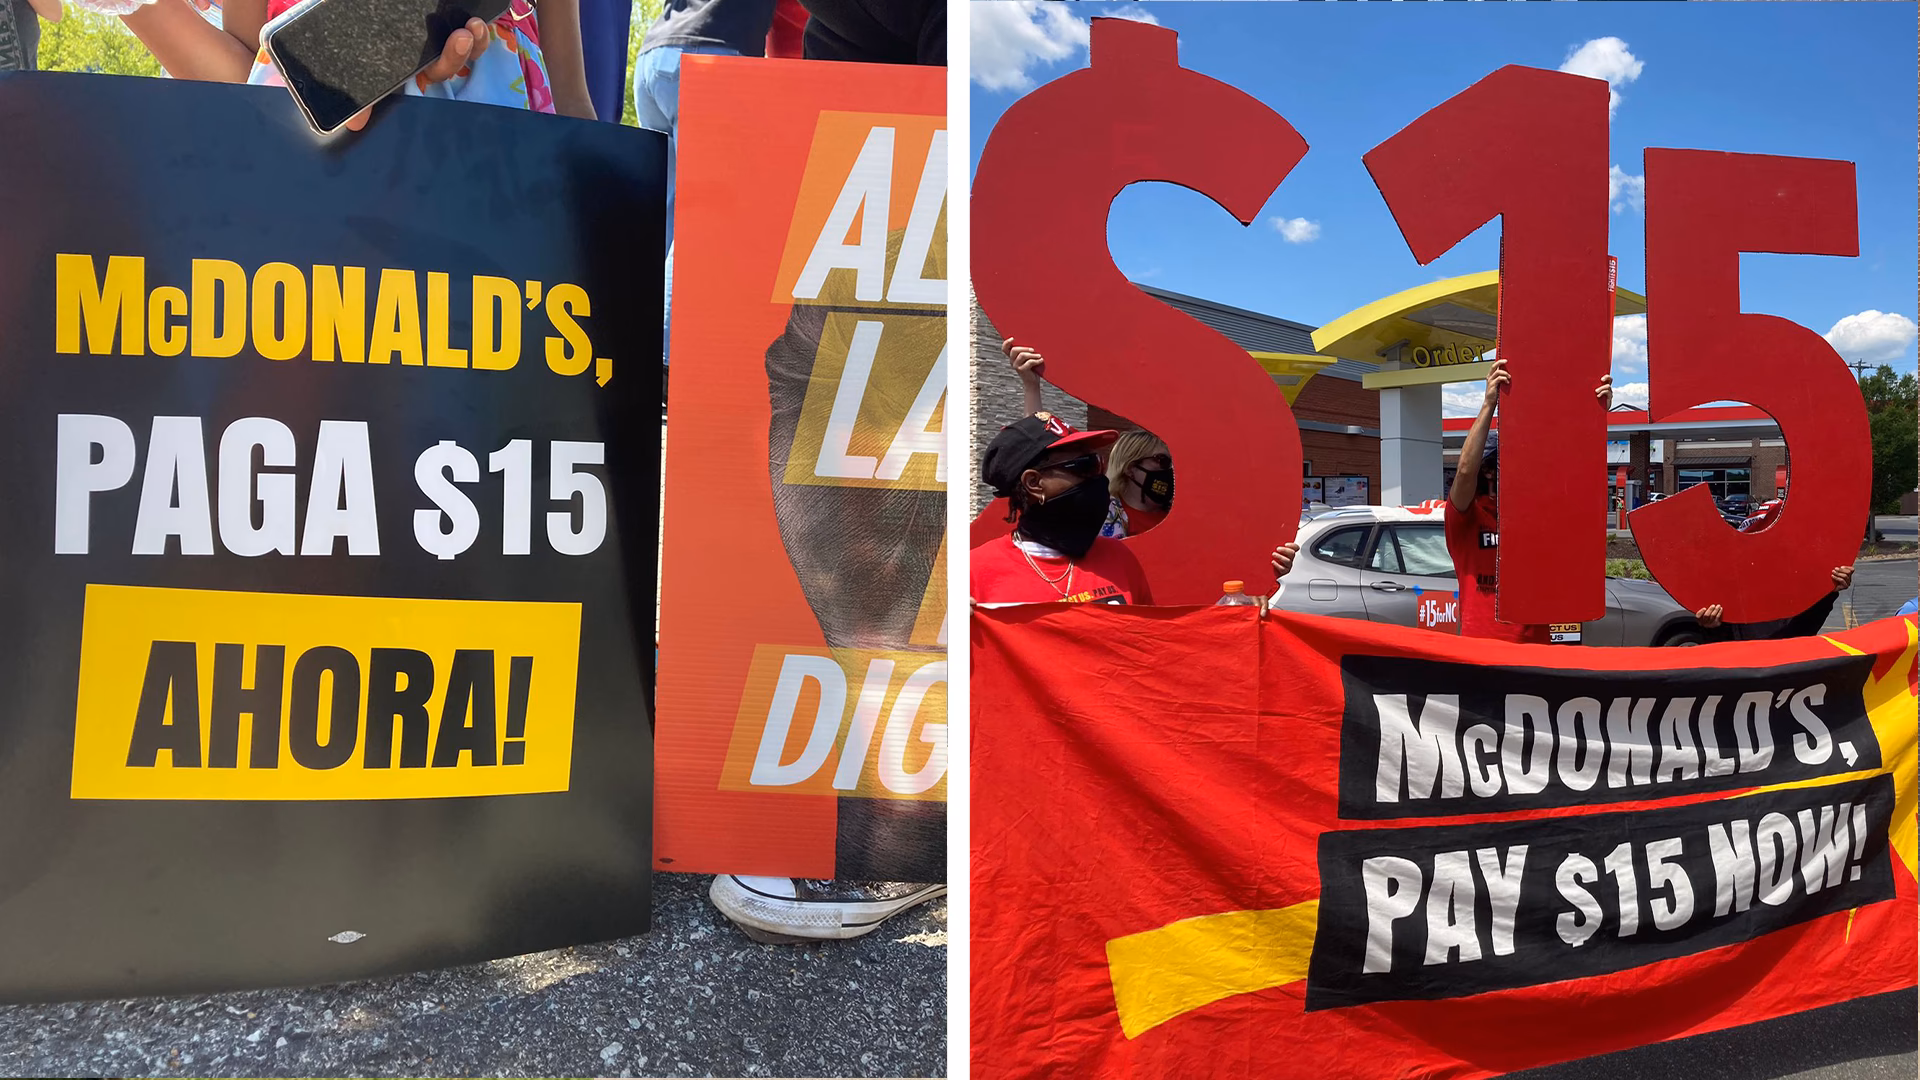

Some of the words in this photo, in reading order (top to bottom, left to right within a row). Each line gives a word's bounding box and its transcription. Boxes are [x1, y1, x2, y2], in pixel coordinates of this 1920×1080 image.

[56, 253, 614, 388] McDONALD'S,
[1412, 342, 1485, 368] Order
[54, 413, 381, 557] PAGA
[413, 439, 608, 560] $15
[1419, 600, 1457, 627] #15forNC
[126, 640, 533, 770] AHORA!
[1372, 683, 1859, 802] McDONALD'S,
[1361, 845, 1530, 975] PAY
[1555, 837, 1696, 948] $15
[1707, 802, 1867, 918] NOW!
